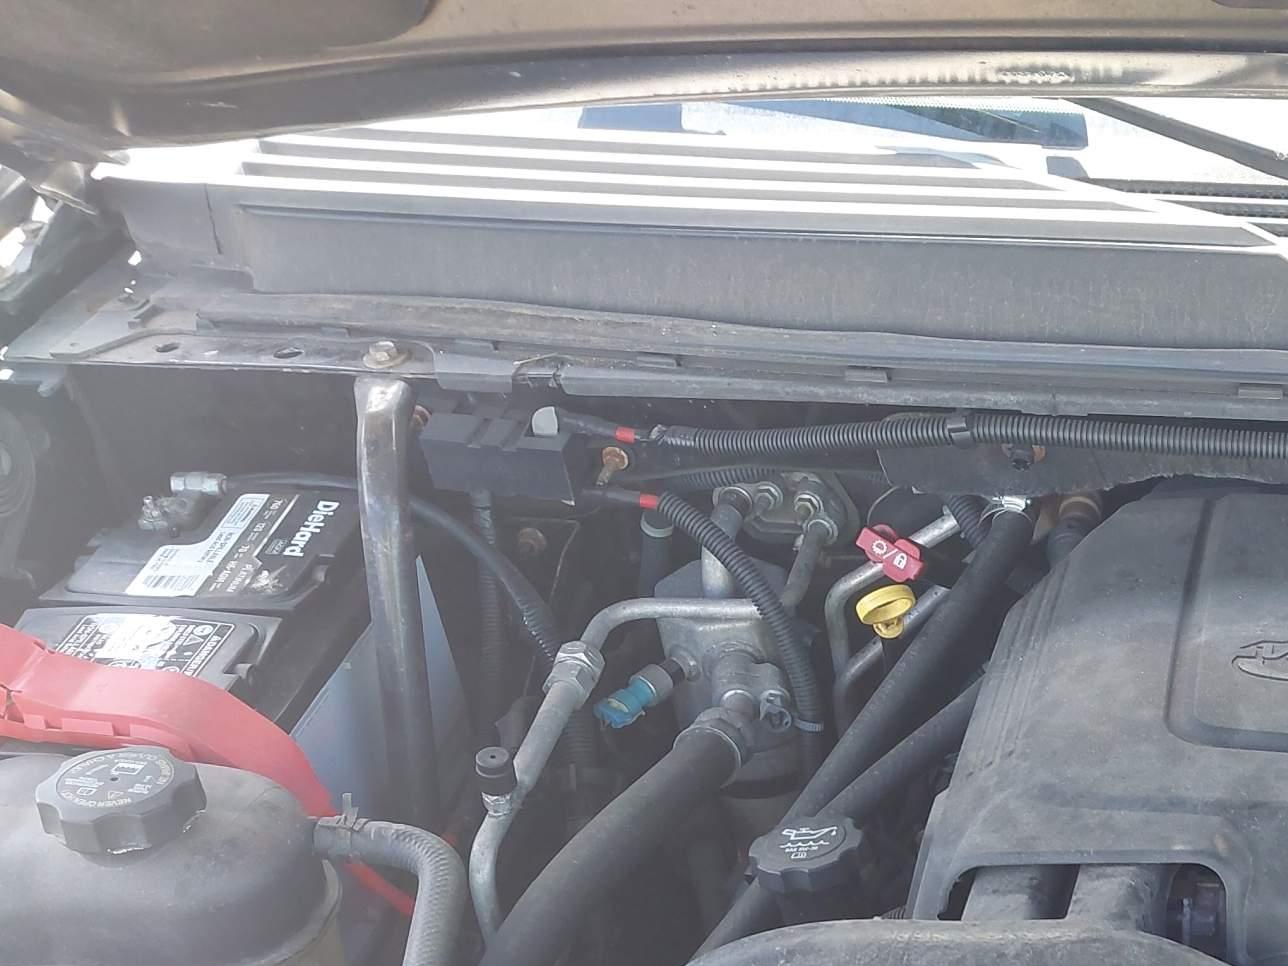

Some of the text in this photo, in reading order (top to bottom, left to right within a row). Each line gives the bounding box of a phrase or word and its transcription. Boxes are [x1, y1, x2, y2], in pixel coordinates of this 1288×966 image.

[283, 500, 340, 557] DieHard
[226, 563, 254, 592] PLATINUM
[97, 797, 132, 808] NEVER
